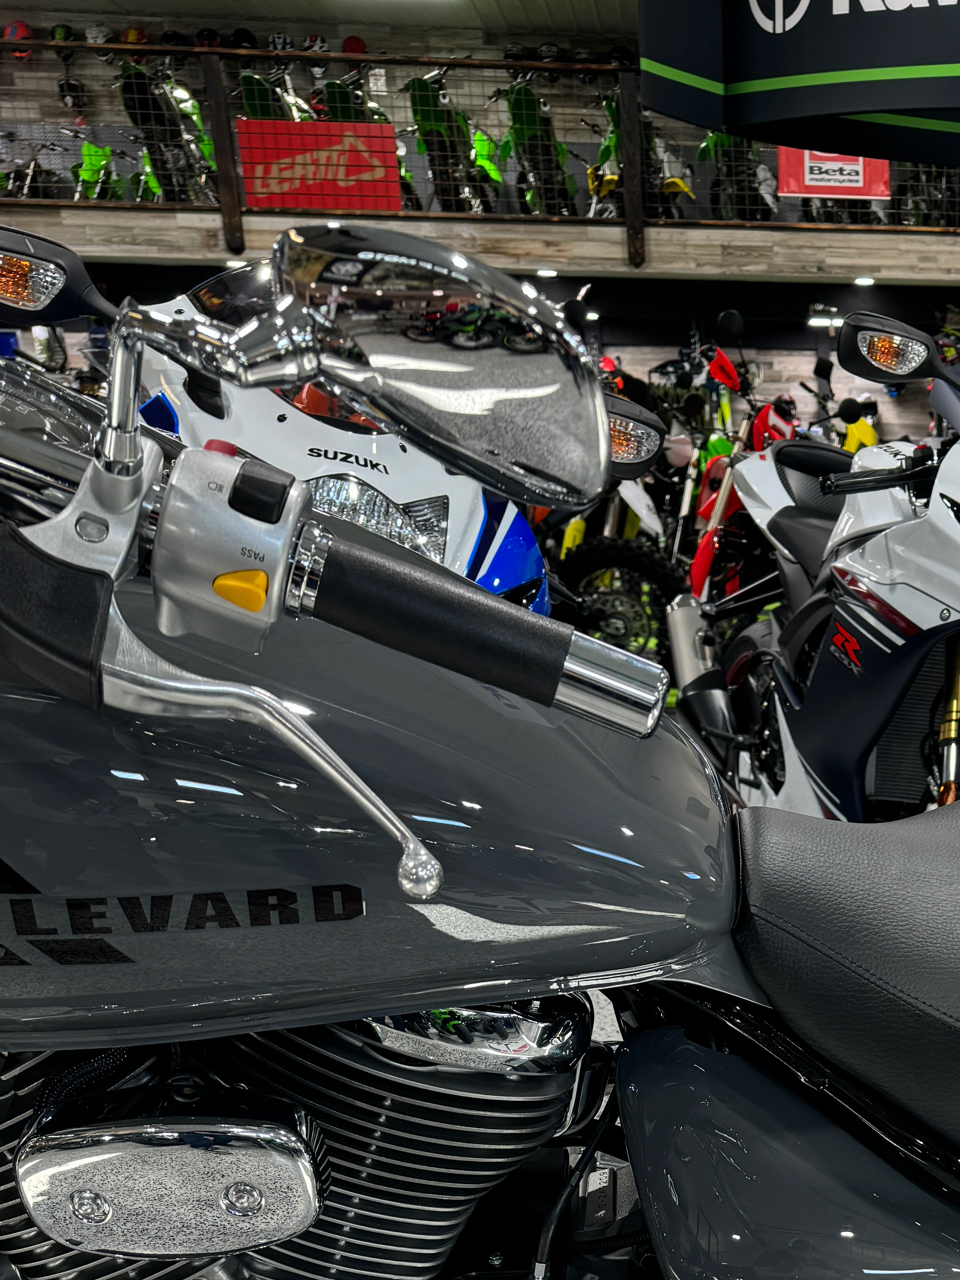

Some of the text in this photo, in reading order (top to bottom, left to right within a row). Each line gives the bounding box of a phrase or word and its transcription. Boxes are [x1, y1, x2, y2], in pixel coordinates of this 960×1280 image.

[808, 165, 860, 176] Beta
[307, 447, 390, 475] SUZUKI
[240, 546, 266, 563] PASS
